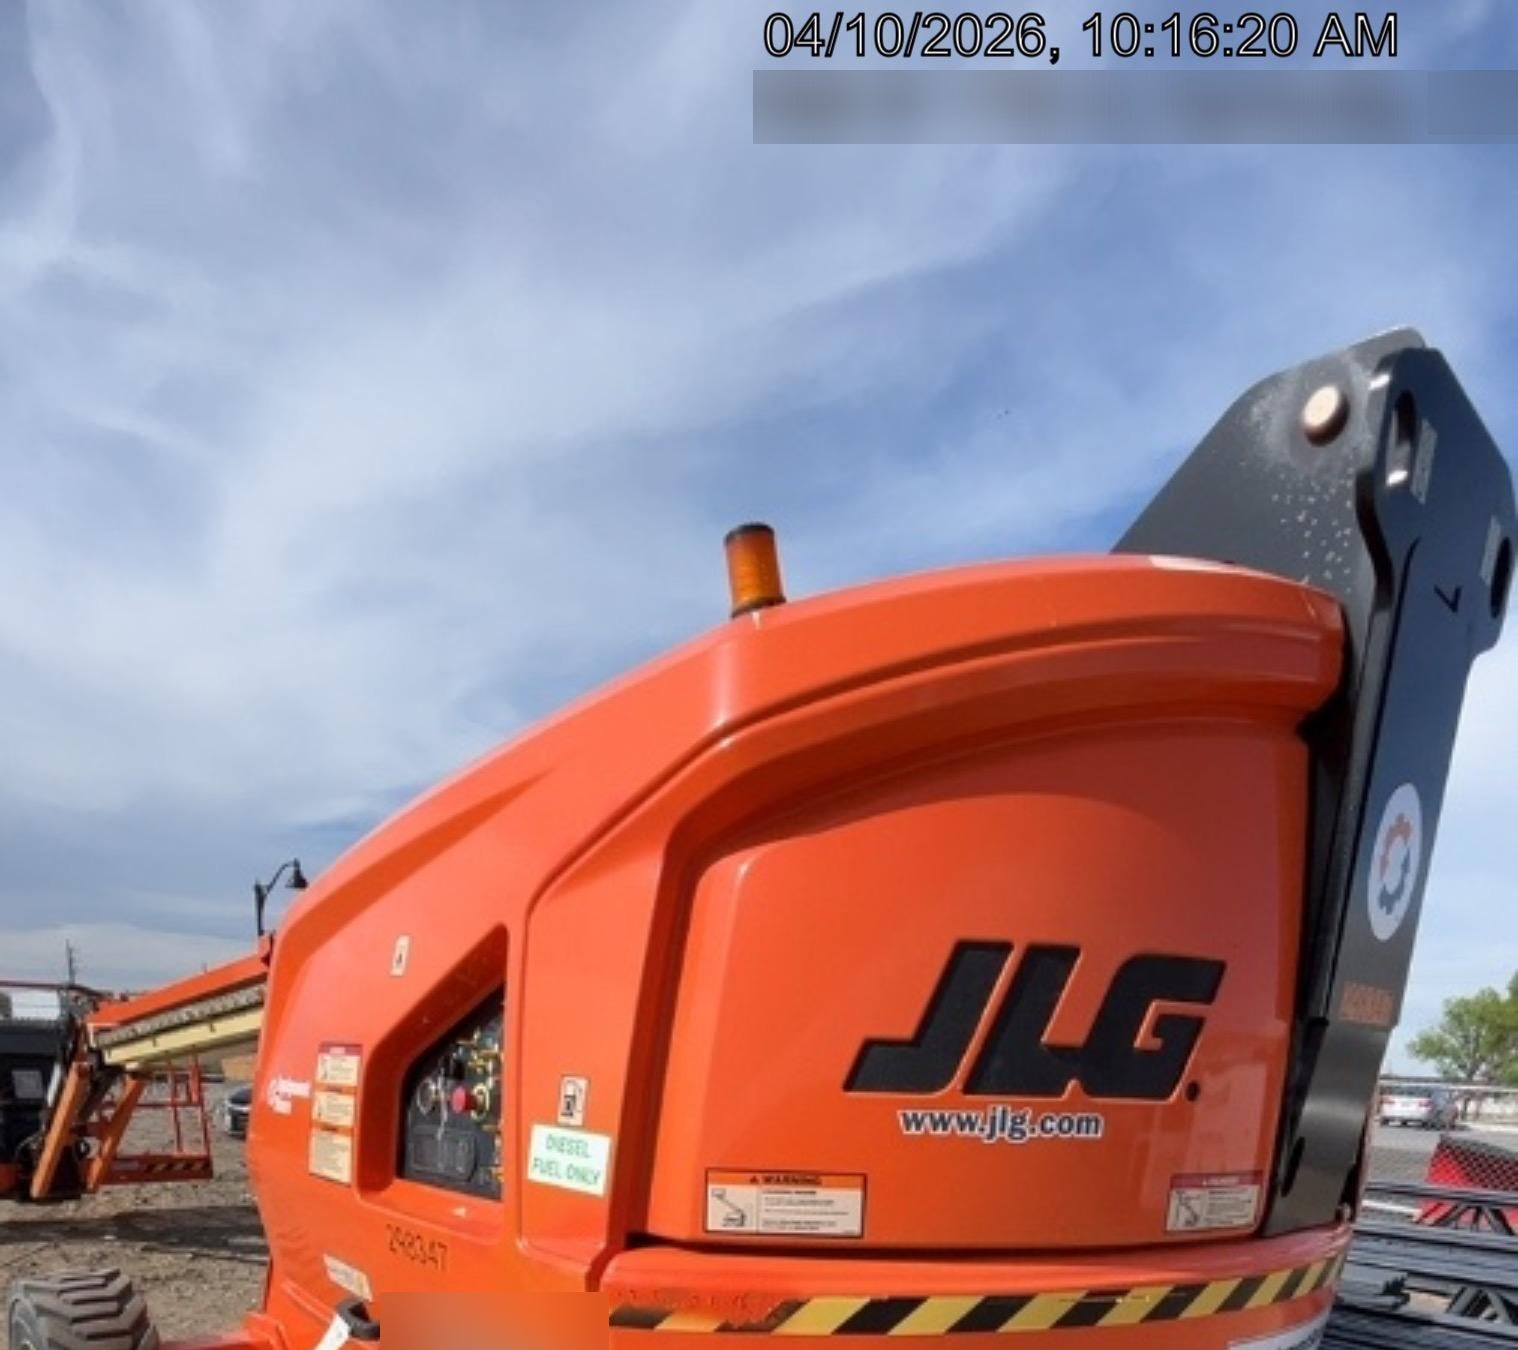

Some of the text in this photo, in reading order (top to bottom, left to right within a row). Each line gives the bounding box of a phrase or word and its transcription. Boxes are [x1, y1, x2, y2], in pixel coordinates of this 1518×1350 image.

[842, 940, 1226, 1101] JLG
[900, 1104, 1104, 1142] www.jlg.com
[532, 1156, 561, 1180] FUEL
